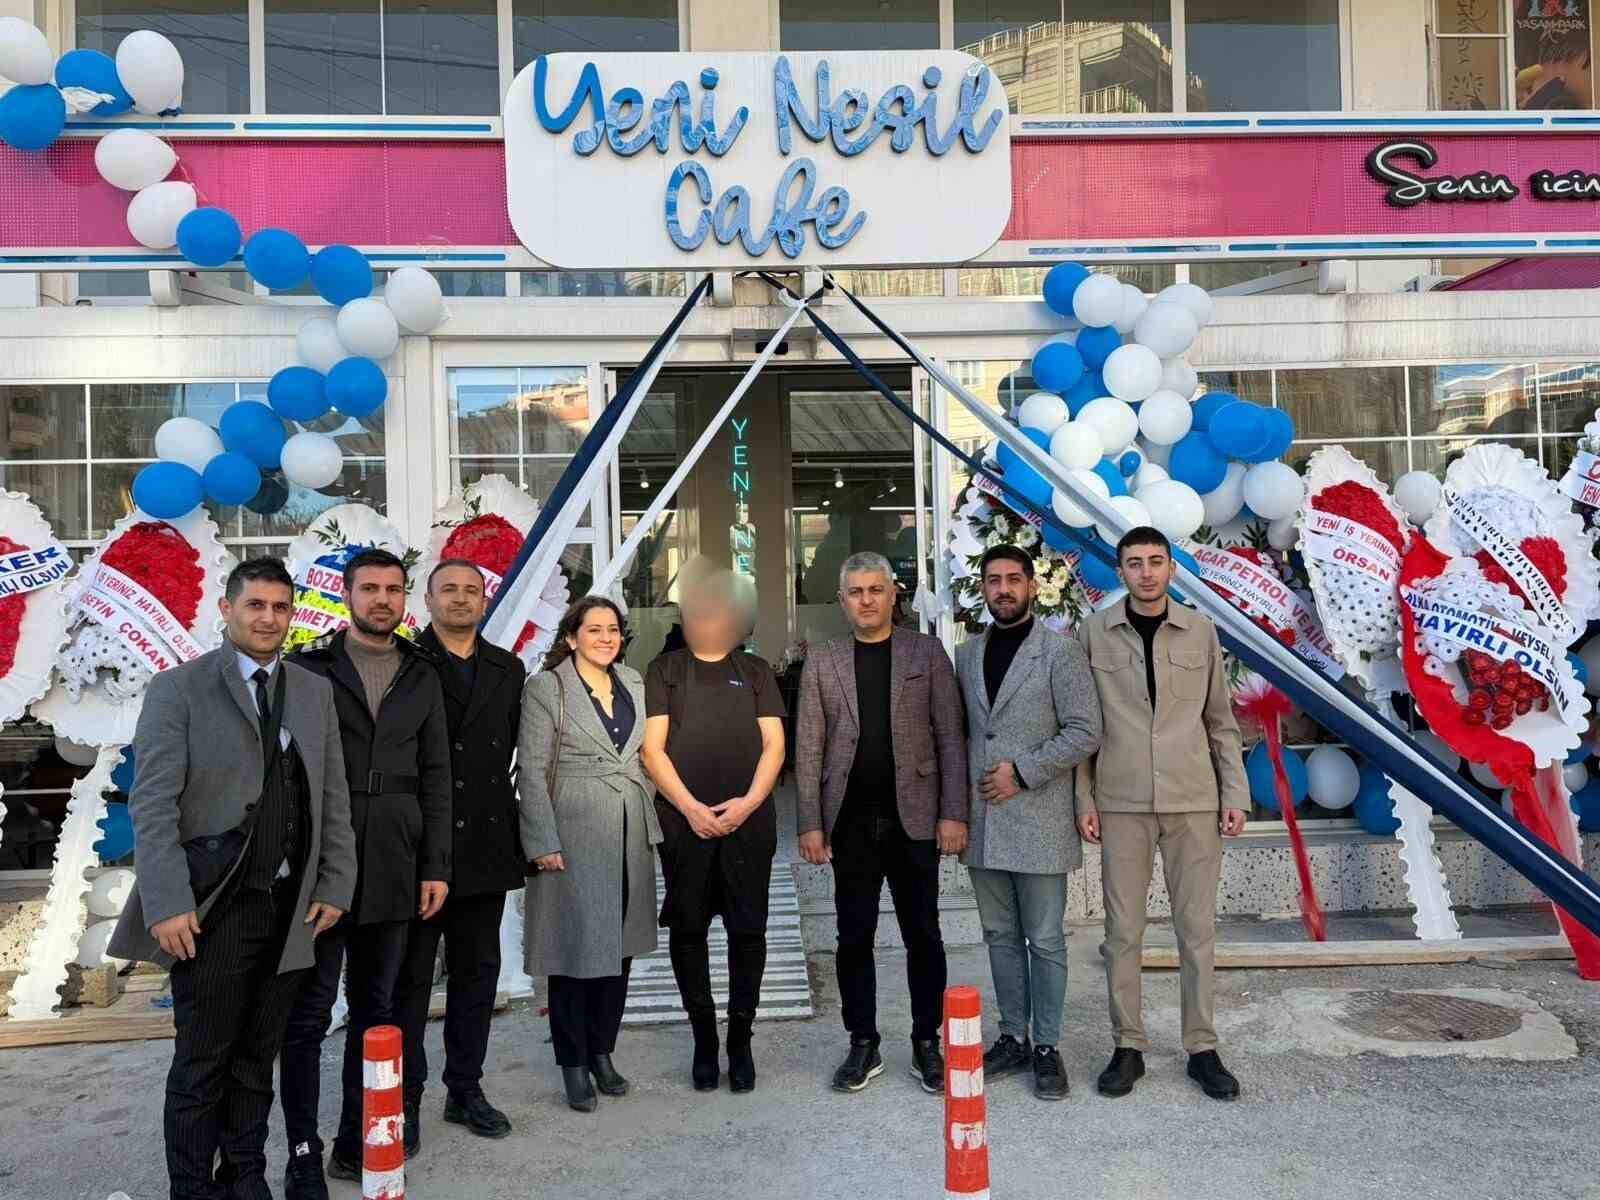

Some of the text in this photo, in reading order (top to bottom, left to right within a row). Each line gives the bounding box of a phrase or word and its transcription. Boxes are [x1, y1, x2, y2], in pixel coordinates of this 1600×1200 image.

[533, 54, 1004, 157] Yeni Nesil
[1373, 141, 1516, 201] Senin
[664, 156, 868, 258] Cafe
[20, 559, 69, 588] OLSUN
[306, 567, 345, 593] BOZB
[1228, 562, 1289, 608] PETROL
[135, 595, 174, 634] HAYIRLI
[171, 633, 200, 661] OLSU
[288, 606, 336, 630] HMET
[118, 621, 170, 672] ÇOKAN
[1411, 611, 1569, 712] HAYIRLI OLSUN
